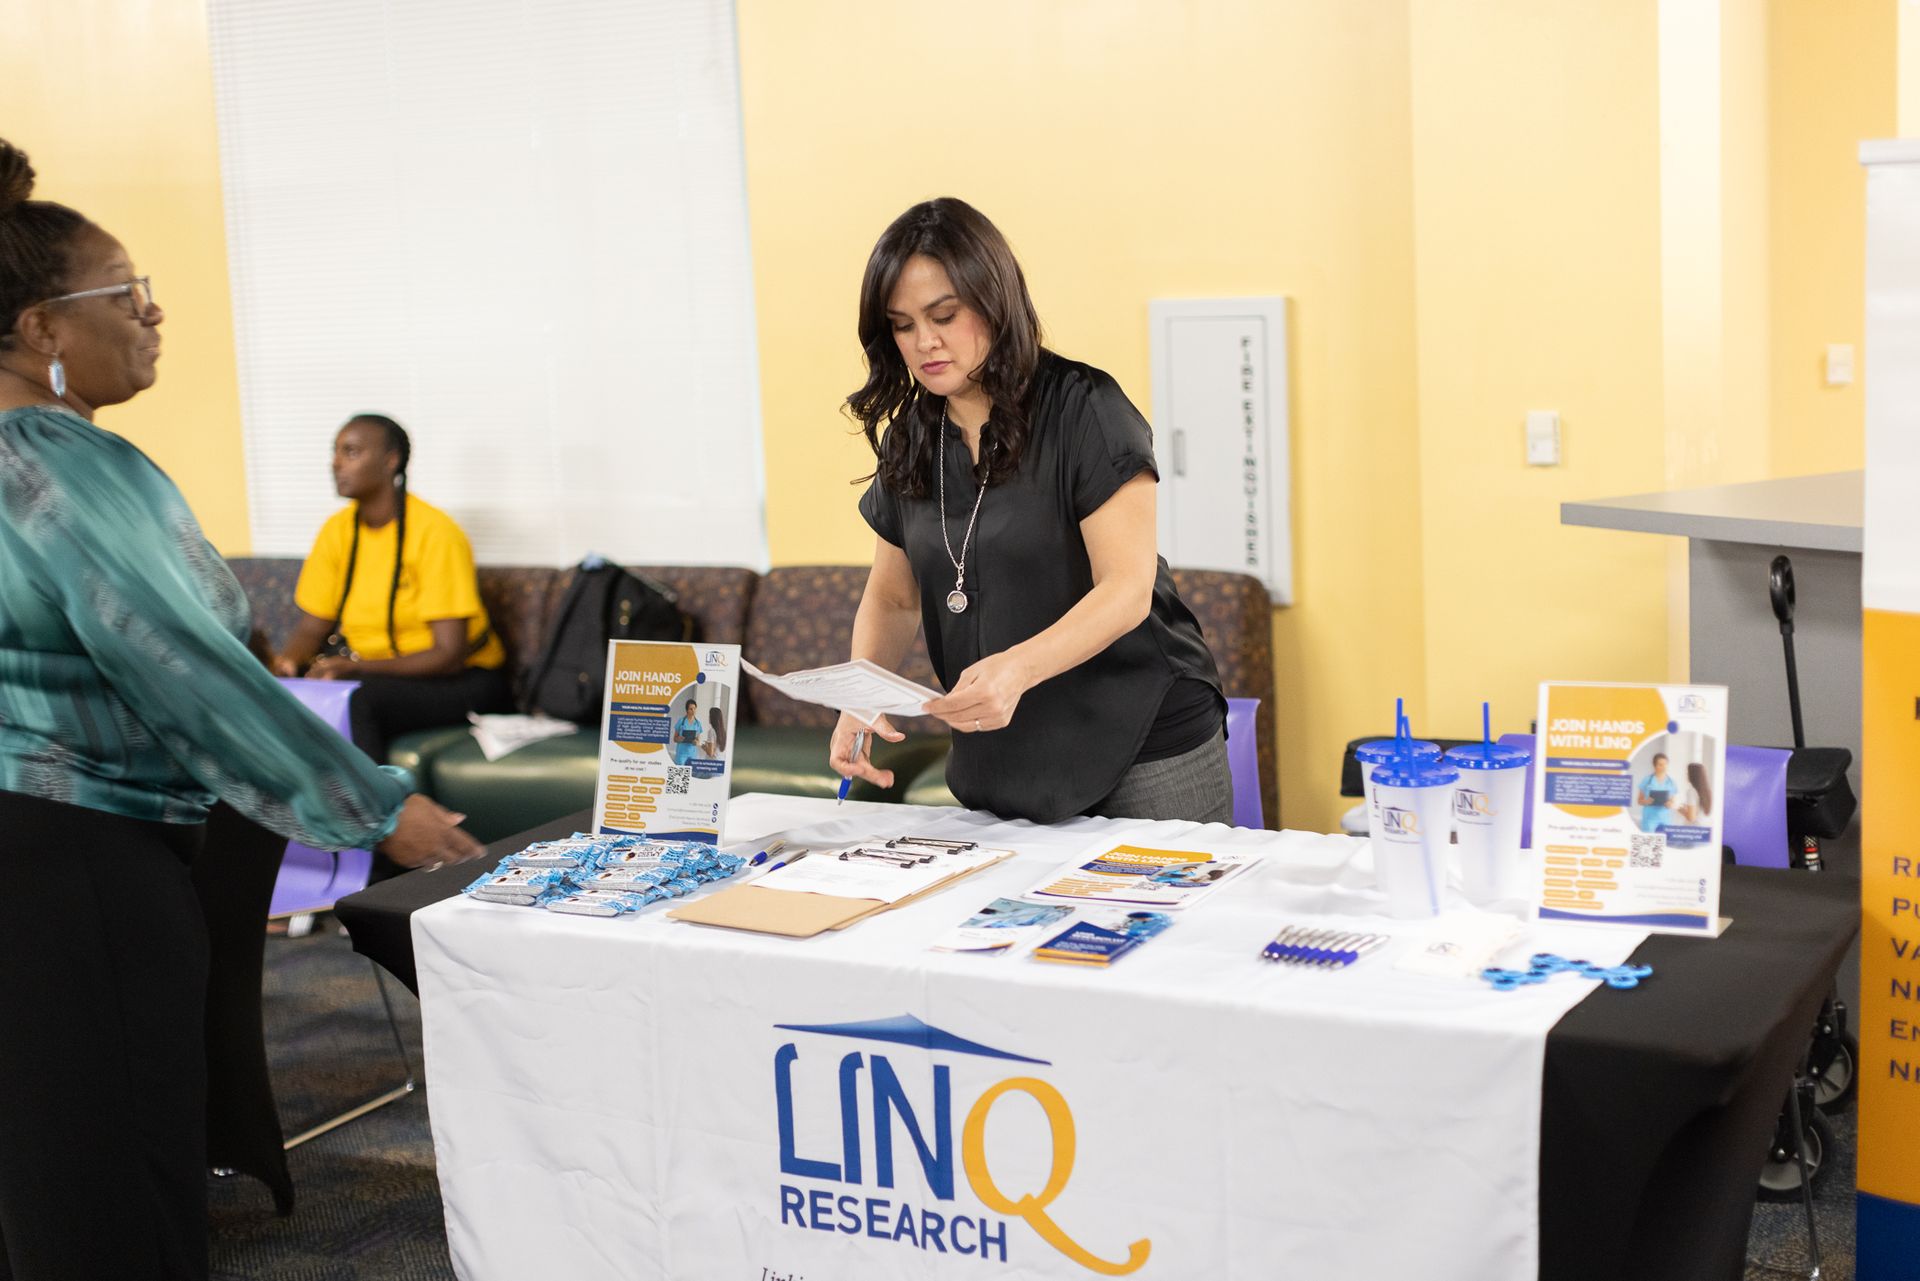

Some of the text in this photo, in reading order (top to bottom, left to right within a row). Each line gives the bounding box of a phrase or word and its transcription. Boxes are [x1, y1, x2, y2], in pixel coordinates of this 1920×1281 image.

[1240, 335, 1253, 392] FIRE
[615, 670, 682, 684] JOIN HANDS
[614, 683, 672, 696] WITH LINQ
[1550, 719, 1645, 735] JOIN HANDS
[1550, 734, 1633, 750] WITH LINQ
[1893, 856, 1920, 878] R
[1891, 978, 1920, 1002] N
[1890, 1059, 1920, 1084] N
[774, 1042, 1152, 1277] LINQ
[780, 1184, 1008, 1263] RESEARCH
